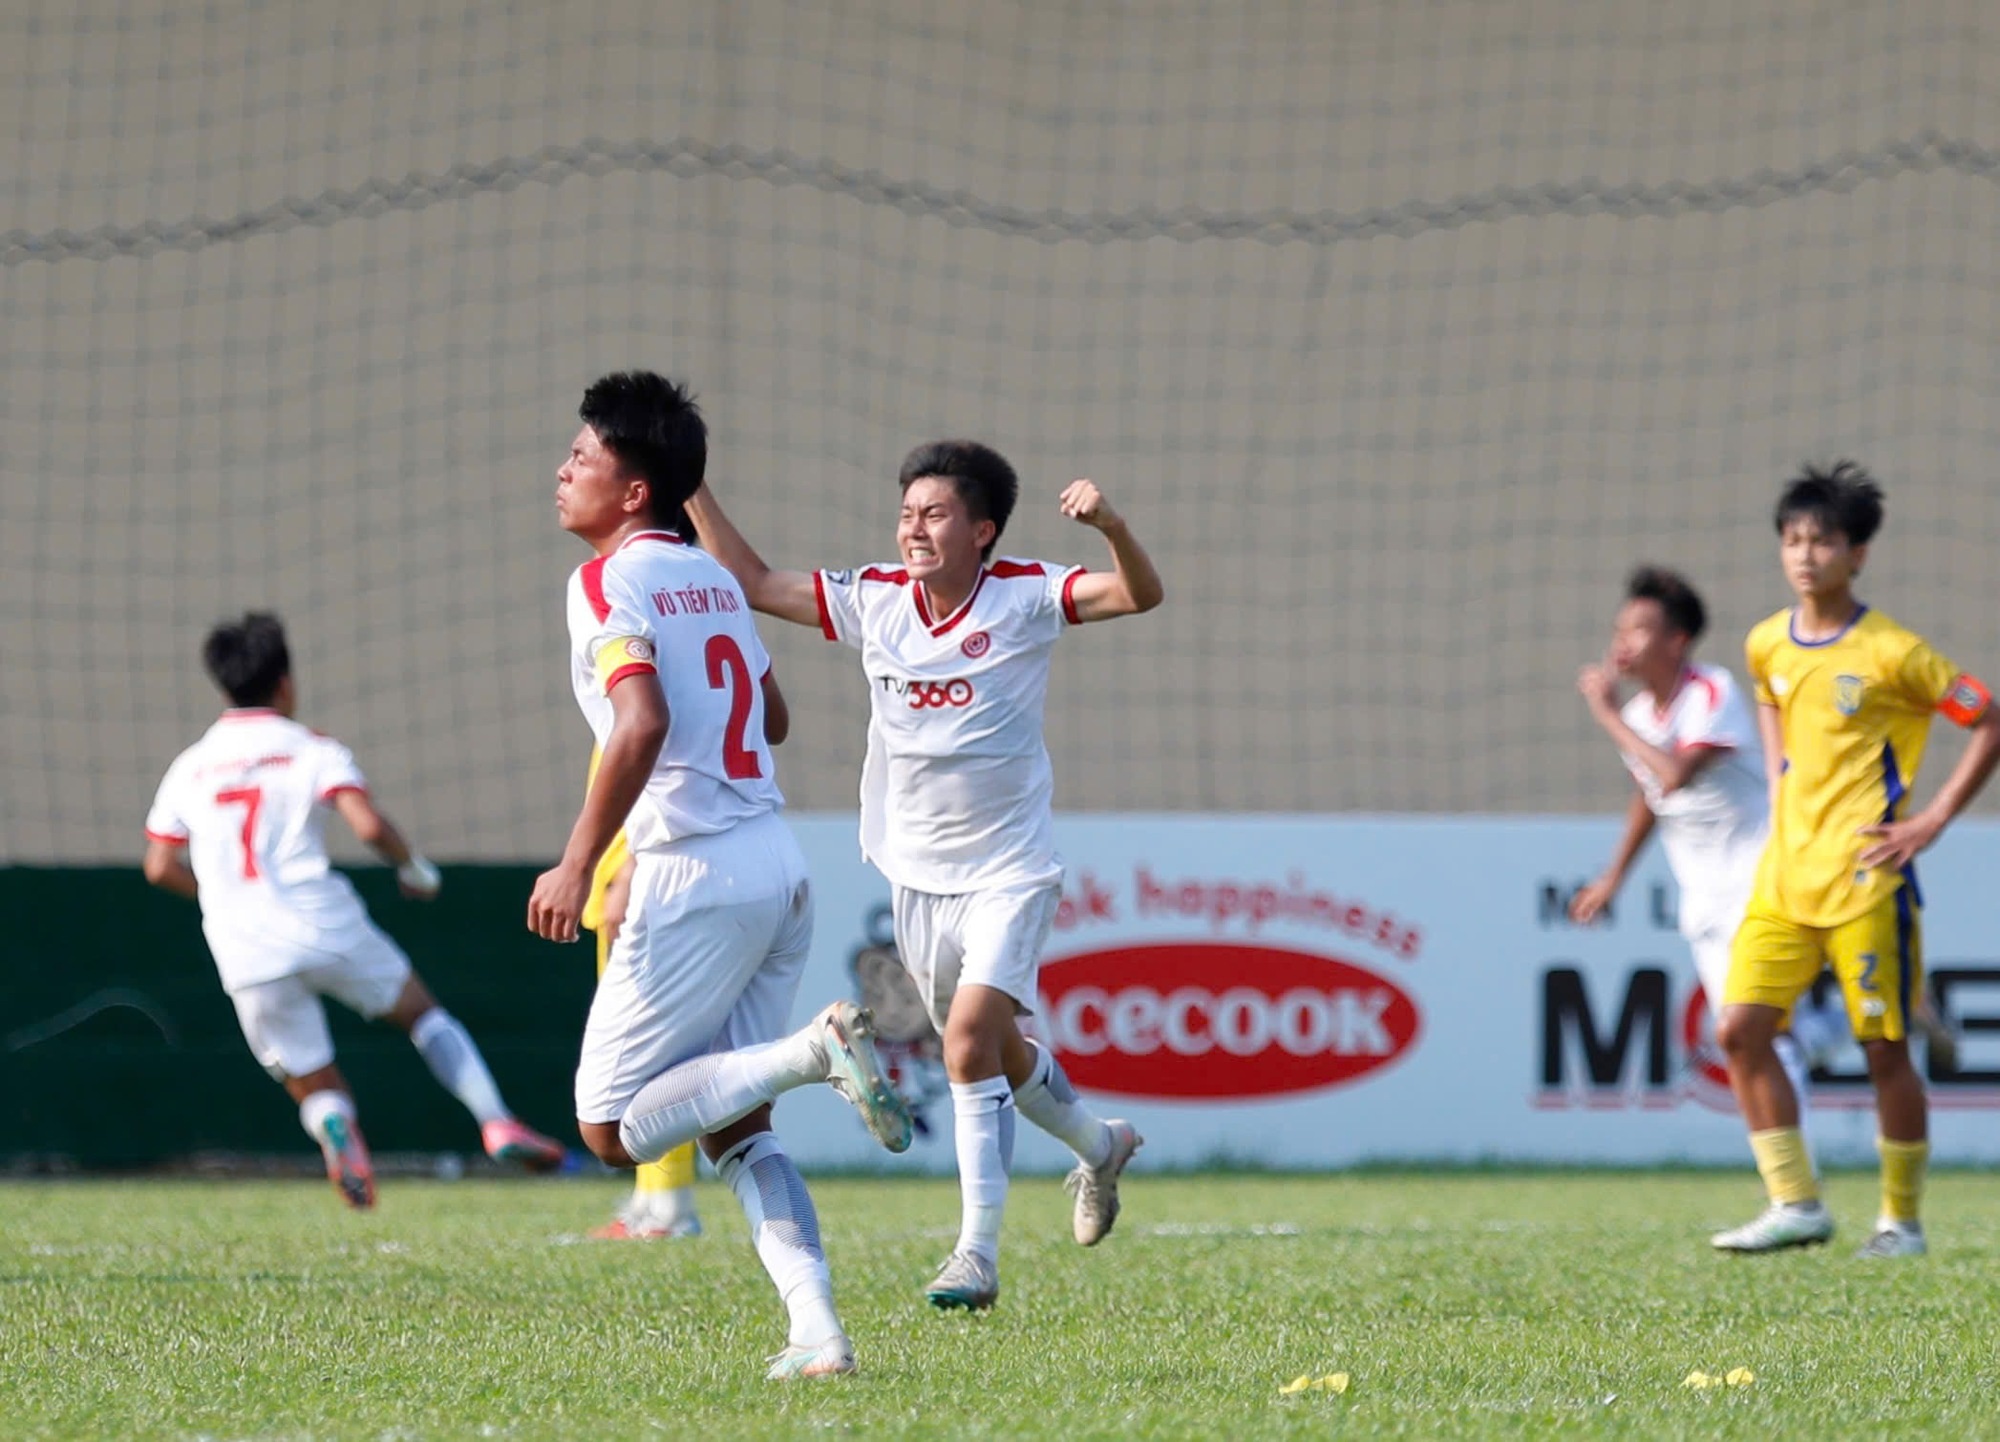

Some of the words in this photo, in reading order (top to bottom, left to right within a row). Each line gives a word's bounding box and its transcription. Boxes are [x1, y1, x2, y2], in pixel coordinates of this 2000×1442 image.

[704, 634, 763, 780] 2
[878, 677, 974, 710] TV360
[216, 786, 261, 879] 7
[1053, 873, 1118, 930] ok
[1133, 866, 1420, 957] happiness
[1858, 951, 1879, 991] 2
